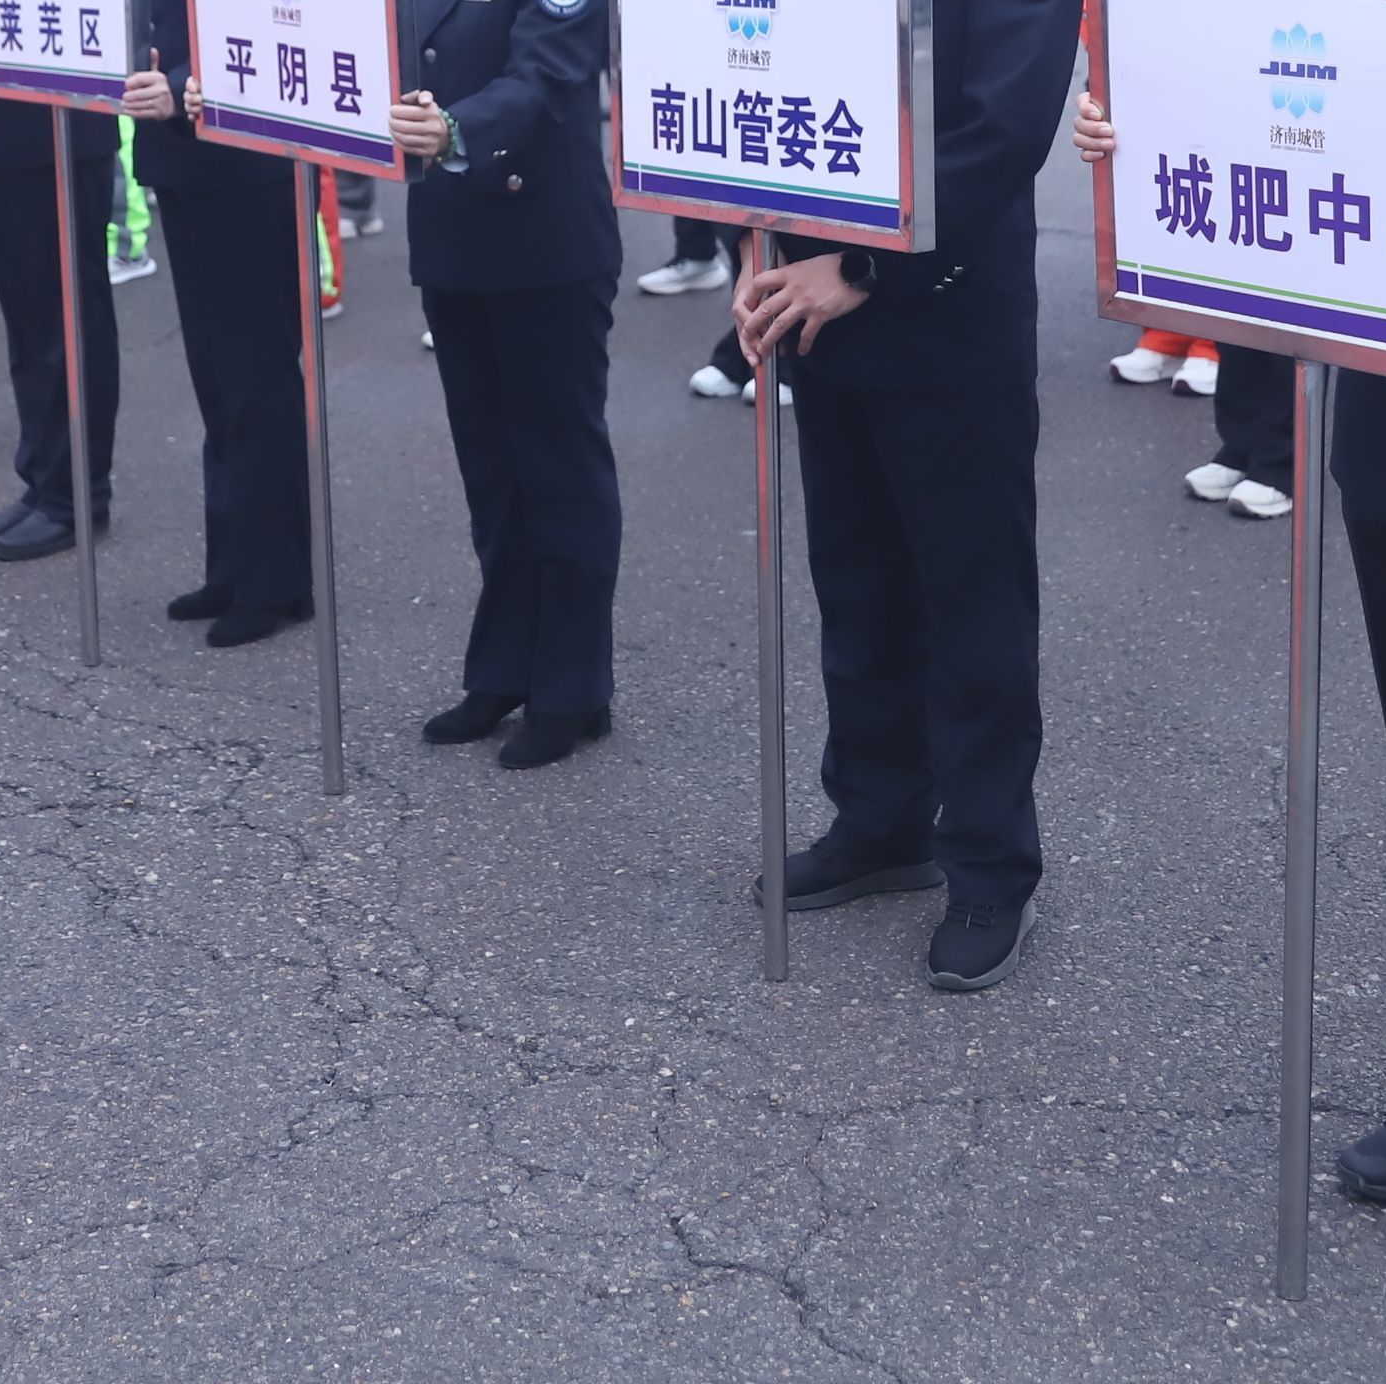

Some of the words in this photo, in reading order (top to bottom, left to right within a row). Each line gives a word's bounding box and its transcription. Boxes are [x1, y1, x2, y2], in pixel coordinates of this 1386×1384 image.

[224, 35, 363, 118] 平阴县
[650, 82, 864, 178] 南山管委会
[1269, 124, 1326, 150] 济南城管
